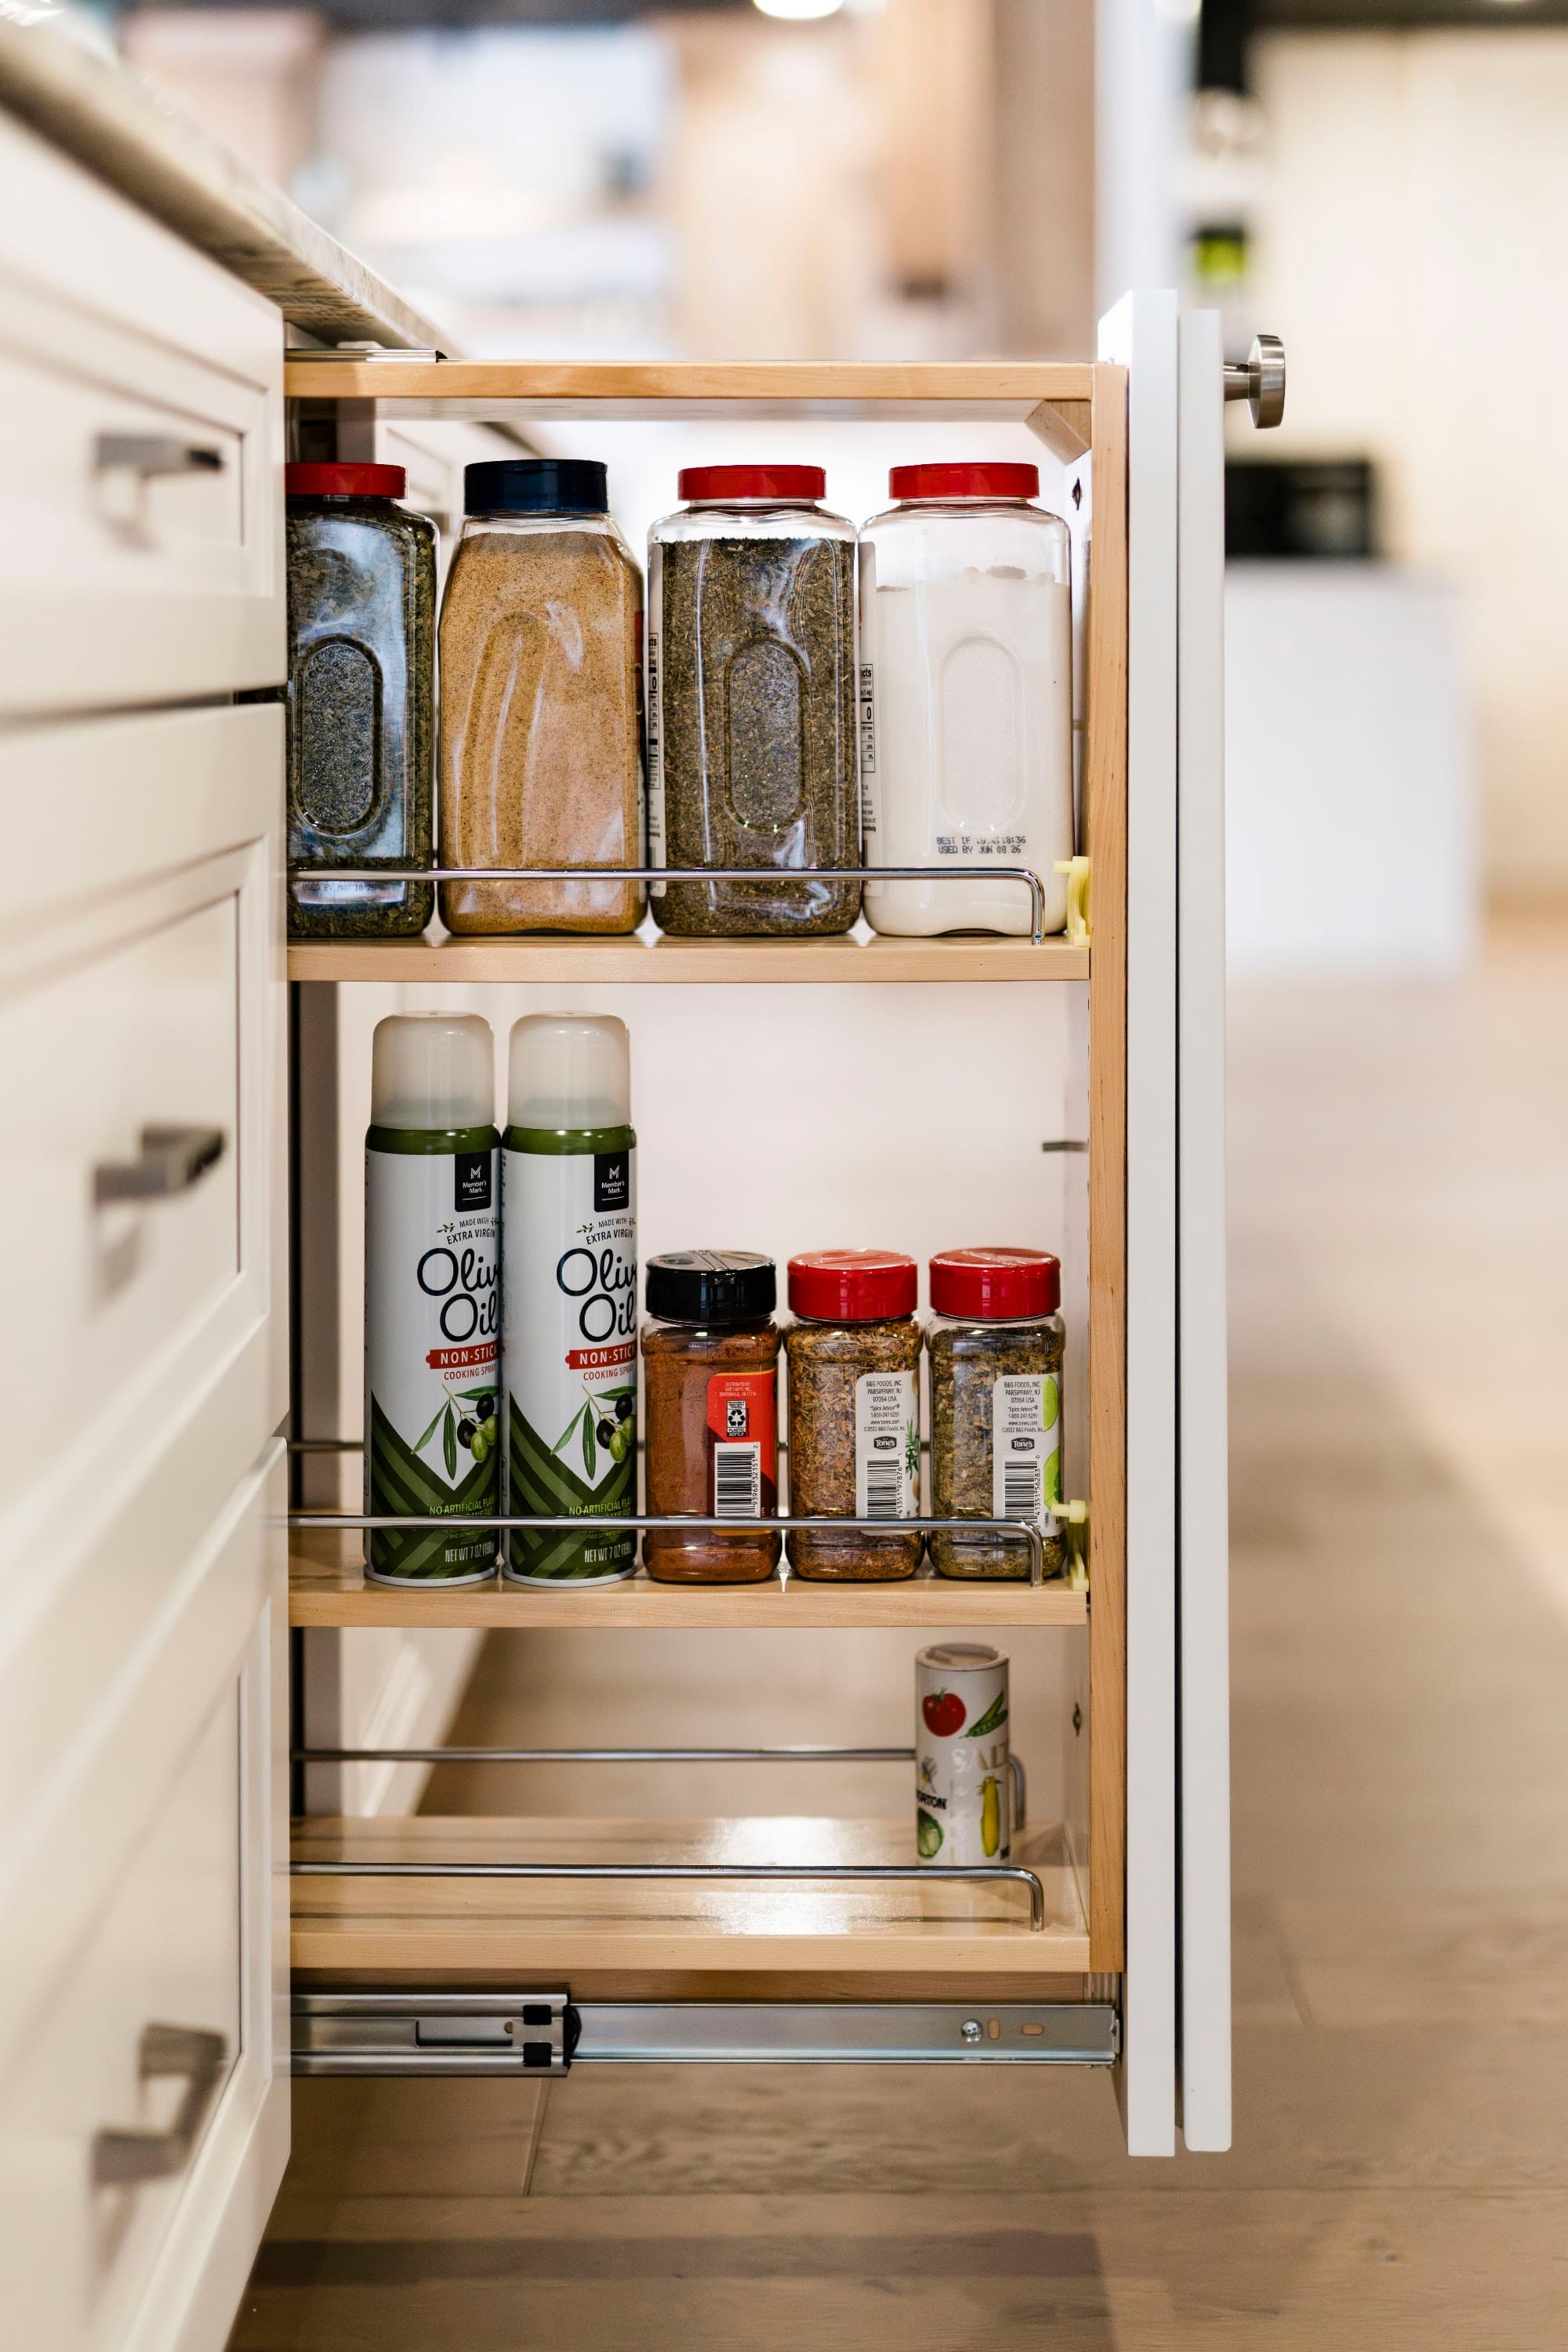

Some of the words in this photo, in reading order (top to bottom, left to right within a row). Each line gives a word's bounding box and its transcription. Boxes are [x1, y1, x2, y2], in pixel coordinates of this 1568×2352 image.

[936, 837, 955, 845] BEST
[938, 845, 958, 854] USED
[1011, 845, 1022, 854] 26
[463, 1180, 486, 1189] Member's
[601, 1180, 625, 1189] Member's
[459, 1218, 476, 1228] MADE
[598, 1218, 615, 1228] MADE
[447, 1230, 473, 1245] EXTRA
[474, 1229, 495, 1238] VIRGIN
[586, 1230, 612, 1245] EXTRA
[613, 1229, 633, 1239] VIRGIN
[417, 1247, 502, 1296] Oliv
[557, 1248, 637, 1296] Oliv
[440, 1290, 499, 1342] Oil
[579, 1290, 636, 1342] Oil
[444, 1368, 479, 1381] COOKING
[583, 1368, 618, 1381] COOKING
[430, 1505, 442, 1515] NO
[444, 1500, 482, 1514] ARTIFICIAL
[569, 1505, 581, 1516] NO
[583, 1500, 620, 1514] ARTIFICIAL
[445, 1548, 458, 1563] NET
[459, 1548, 469, 1561] WT
[470, 1546, 474, 1559] 7
[475, 1544, 482, 1558] OZ
[584, 1548, 597, 1563] NET
[597, 1548, 608, 1562] WT
[608, 1546, 612, 1559] 7
[614, 1544, 621, 1559] OZ
